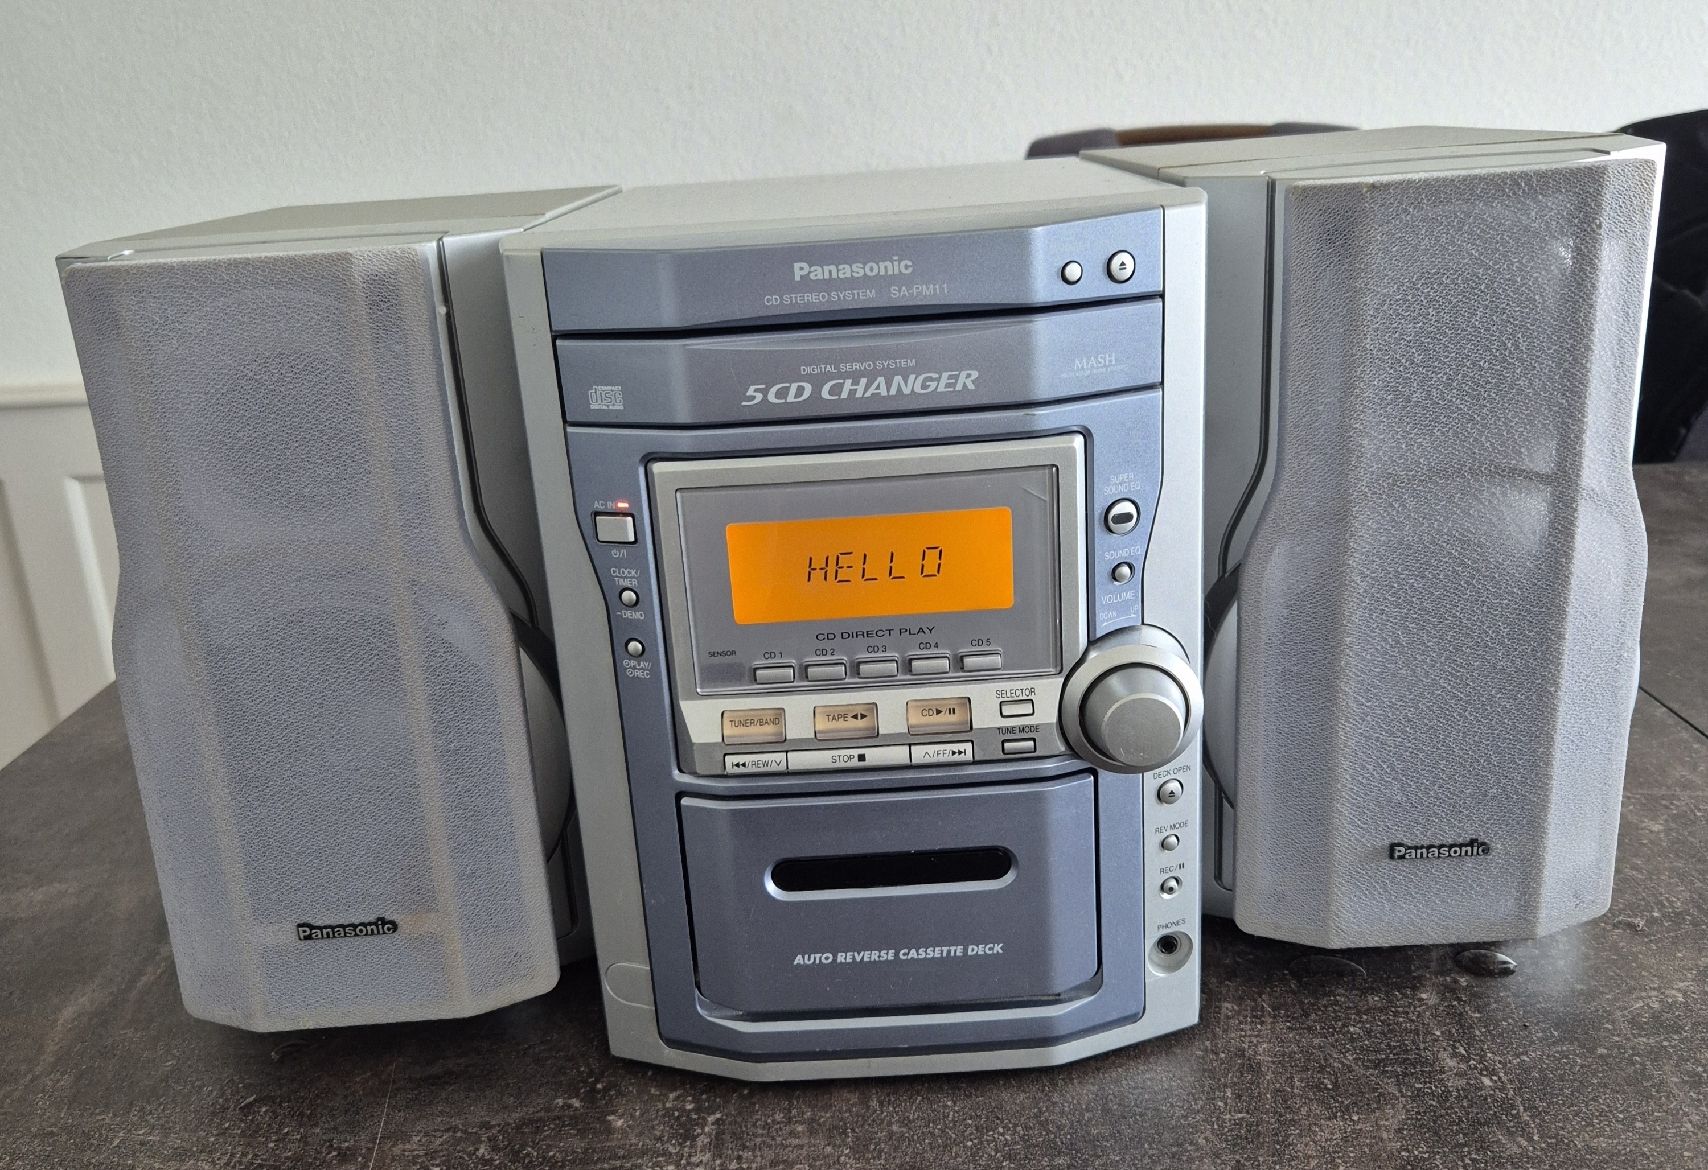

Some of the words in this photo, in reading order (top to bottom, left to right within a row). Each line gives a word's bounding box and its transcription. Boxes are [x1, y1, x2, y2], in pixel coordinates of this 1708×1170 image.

[793, 257, 913, 281] Panasonic
[764, 295, 780, 306] CD
[782, 292, 828, 304] STEREO
[830, 289, 876, 301] SYSTEM
[890, 283, 949, 299] SA-PM11
[800, 364, 837, 375] DIGITAL
[840, 361, 874, 373] SERVO
[876, 359, 916, 370] SYSTEM
[1074, 352, 1116, 370] MASH
[821, 370, 979, 401] CHANGER
[1110, 473, 1134, 484] SUPER
[1104, 483, 1129, 496] SOUND
[593, 500, 606, 510] AC
[1104, 548, 1129, 560] SOUND
[807, 546, 943, 584] HELLO
[610, 567, 640, 577] CLOCK/
[613, 577, 639, 588] TIMER
[1101, 590, 1136, 604] VOLUME
[815, 631, 837, 642] CD
[840, 628, 895, 640] DIRECT
[899, 626, 936, 637] PLAY
[918, 641, 932, 651] CD
[933, 641, 940, 650] 4
[970, 638, 984, 648] CD
[985, 637, 992, 647] 5
[708, 649, 737, 658] SENSOR
[814, 648, 829, 657] CD
[830, 647, 836, 657] 2
[866, 644, 880, 654] CD
[881, 644, 888, 654] 3
[763, 651, 777, 660] CD
[995, 687, 1037, 699] SELECTOR
[825, 713, 849, 723] TAPE
[920, 707, 935, 718] CD
[729, 716, 781, 729] TUNER/BAND
[997, 726, 1017, 736] TUNE
[1018, 724, 1041, 735] MODE
[831, 755, 856, 765] STOP
[1153, 769, 1171, 780] DECK
[1172, 764, 1191, 775] OPEN
[1154, 825, 1169, 835] REV
[1170, 820, 1189, 831] MODE
[1393, 843, 1489, 860] Panasonic
[1157, 918, 1186, 930] PHONES
[298, 921, 396, 941] Panasonic
[793, 952, 834, 966] AUTO
[836, 949, 895, 964] REVERSE
[898, 945, 964, 960] CASSETTE
[967, 943, 1004, 956] DECK
